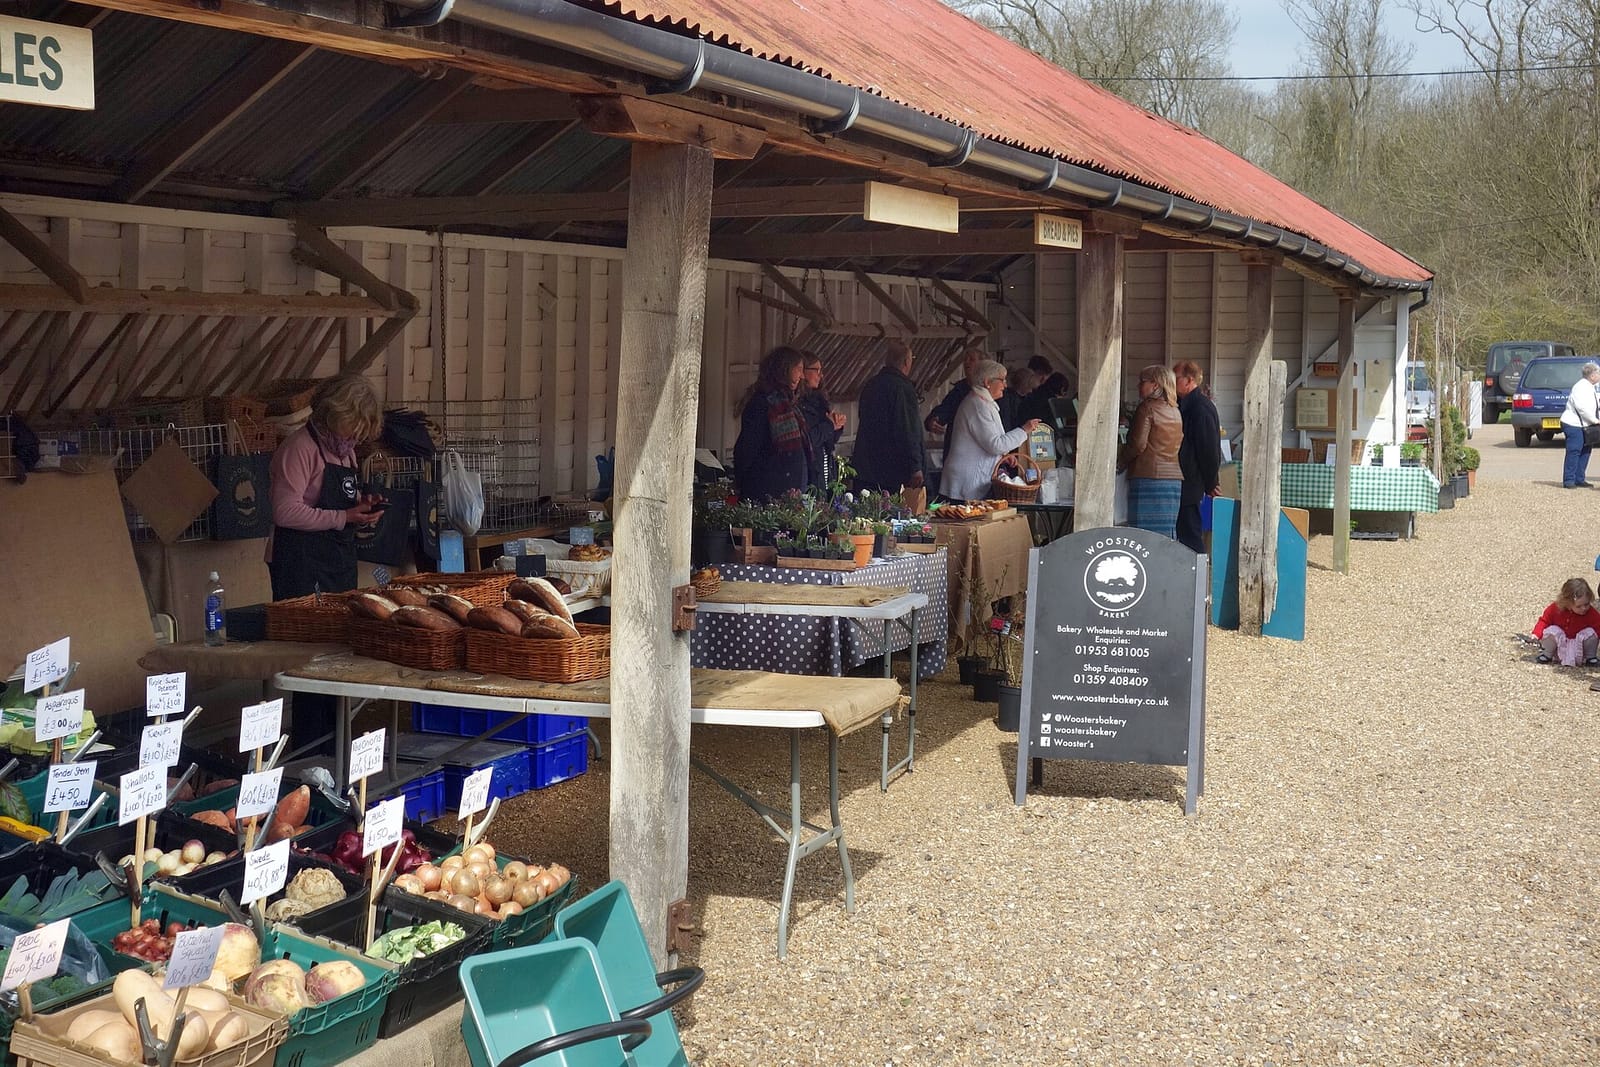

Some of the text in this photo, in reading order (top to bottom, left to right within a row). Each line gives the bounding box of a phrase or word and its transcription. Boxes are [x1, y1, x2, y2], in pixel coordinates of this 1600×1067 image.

[1043, 219, 1062, 241] BREAD
[1067, 223, 1079, 243] PIES
[1085, 537, 1150, 558] WOOSTER'S
[1099, 610, 1130, 618] BAKERY
[1057, 625, 1168, 637] Bakery Wholesale and Market
[1095, 636, 1130, 645] Enquiries:
[1075, 646, 1149, 657] 01953 681005
[1083, 664, 1139, 674] Shop Enquiries:
[1074, 674, 1149, 687] 01359 408409
[44, 696, 79, 711] Asparagus
[1052, 694, 1169, 706] www.woostersbakery.co.uk
[1055, 713, 1127, 727] @Woostersbakery
[1055, 727, 1117, 738] woostersbakery
[1054, 739, 1094, 748] Wooster's
